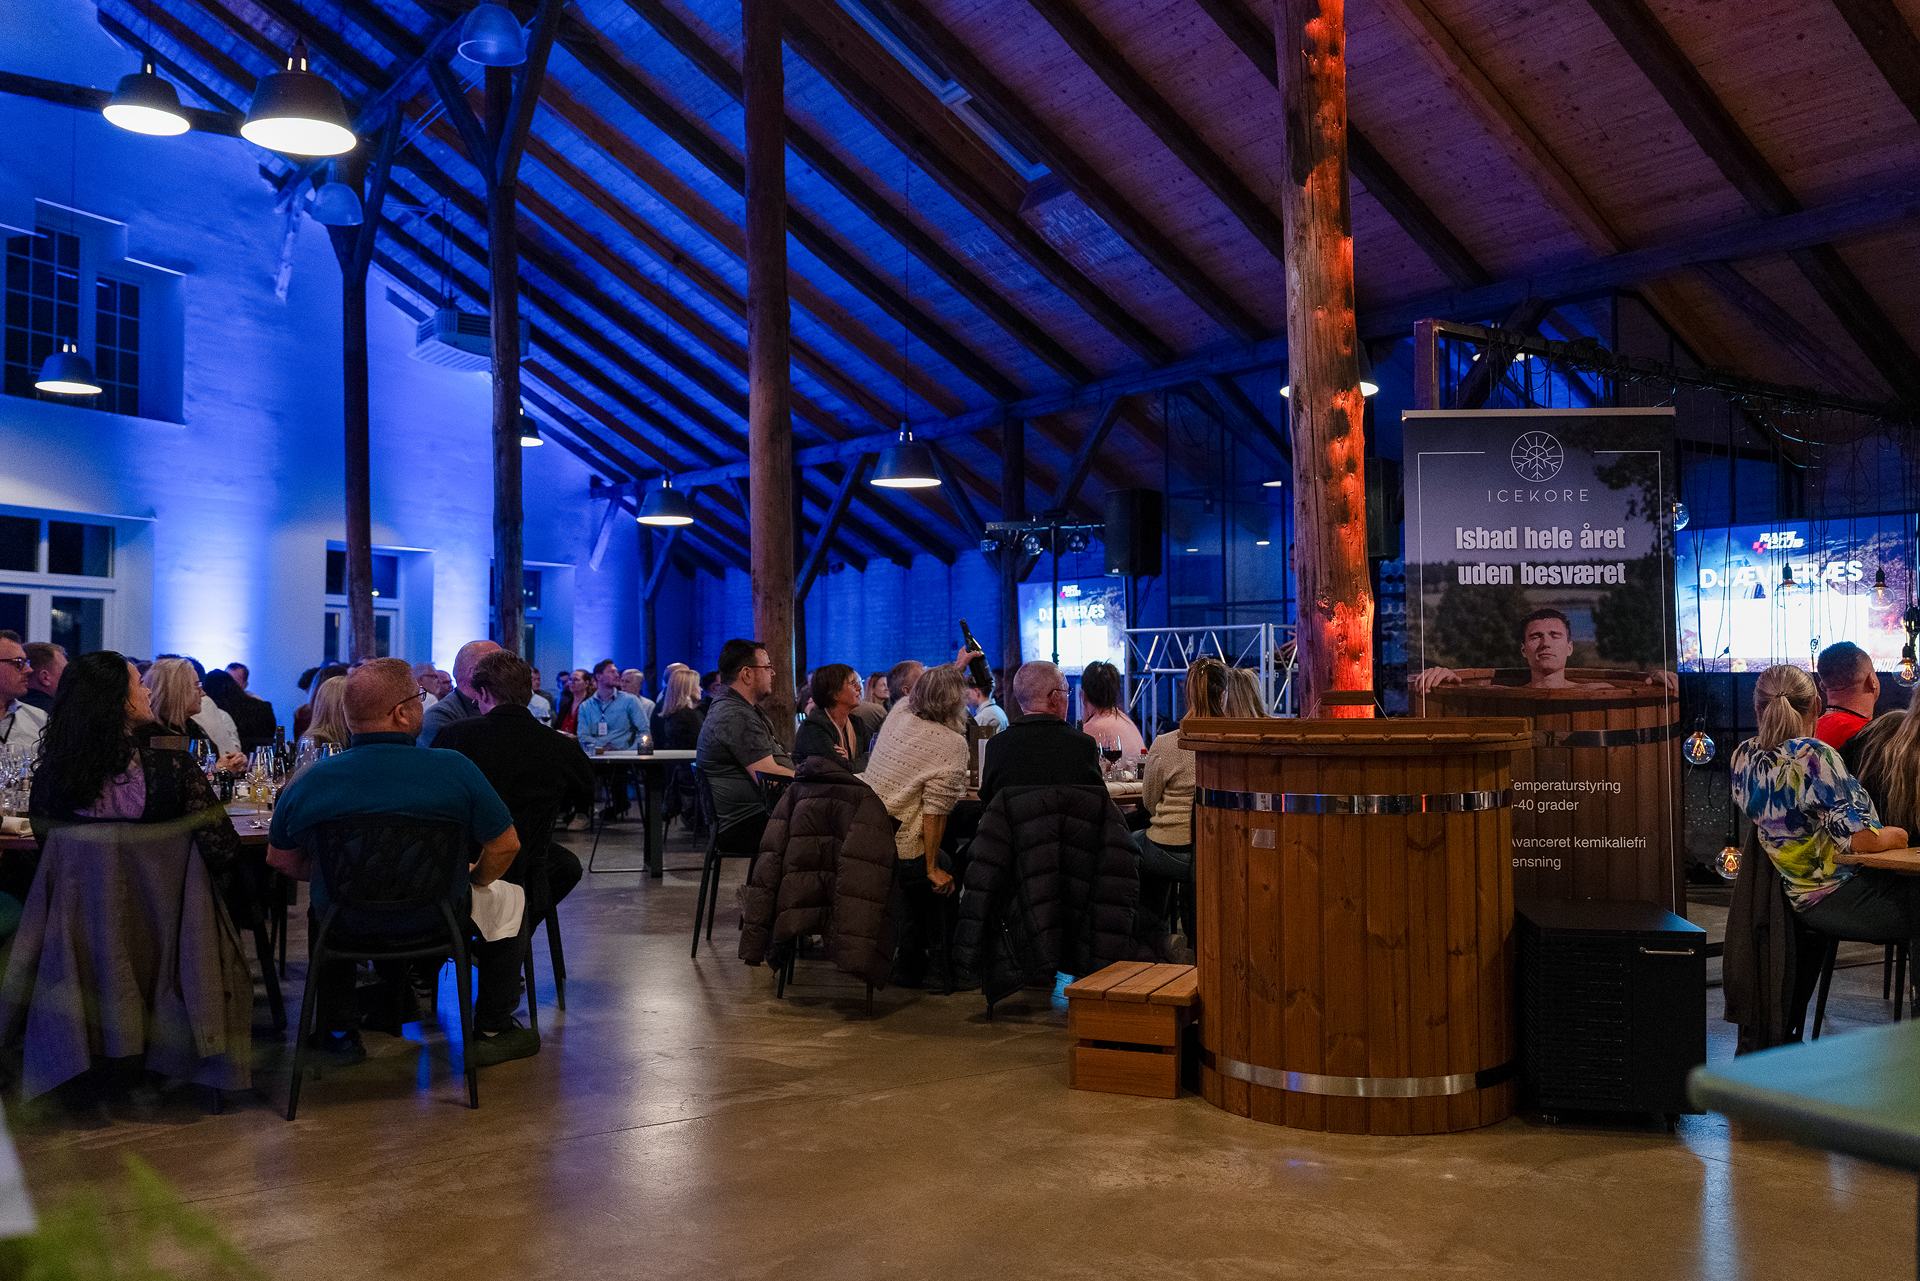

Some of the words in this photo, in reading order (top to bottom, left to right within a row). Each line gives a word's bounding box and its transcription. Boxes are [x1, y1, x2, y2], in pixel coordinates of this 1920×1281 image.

[1487, 488, 1590, 502] ICEKORE
[1456, 527, 1518, 550] Isbad
[1524, 527, 1573, 549] hele
[1580, 523, 1626, 549] året
[1457, 562, 1514, 586] uden
[1520, 562, 1626, 586] besværet
[1511, 779, 1621, 794] emperaturstyring
[1511, 799, 1534, 811] -40
[1537, 799, 1580, 814] grader
[1574, 836, 1647, 849] kemikaliefri
[1511, 855, 1562, 871] ensning
